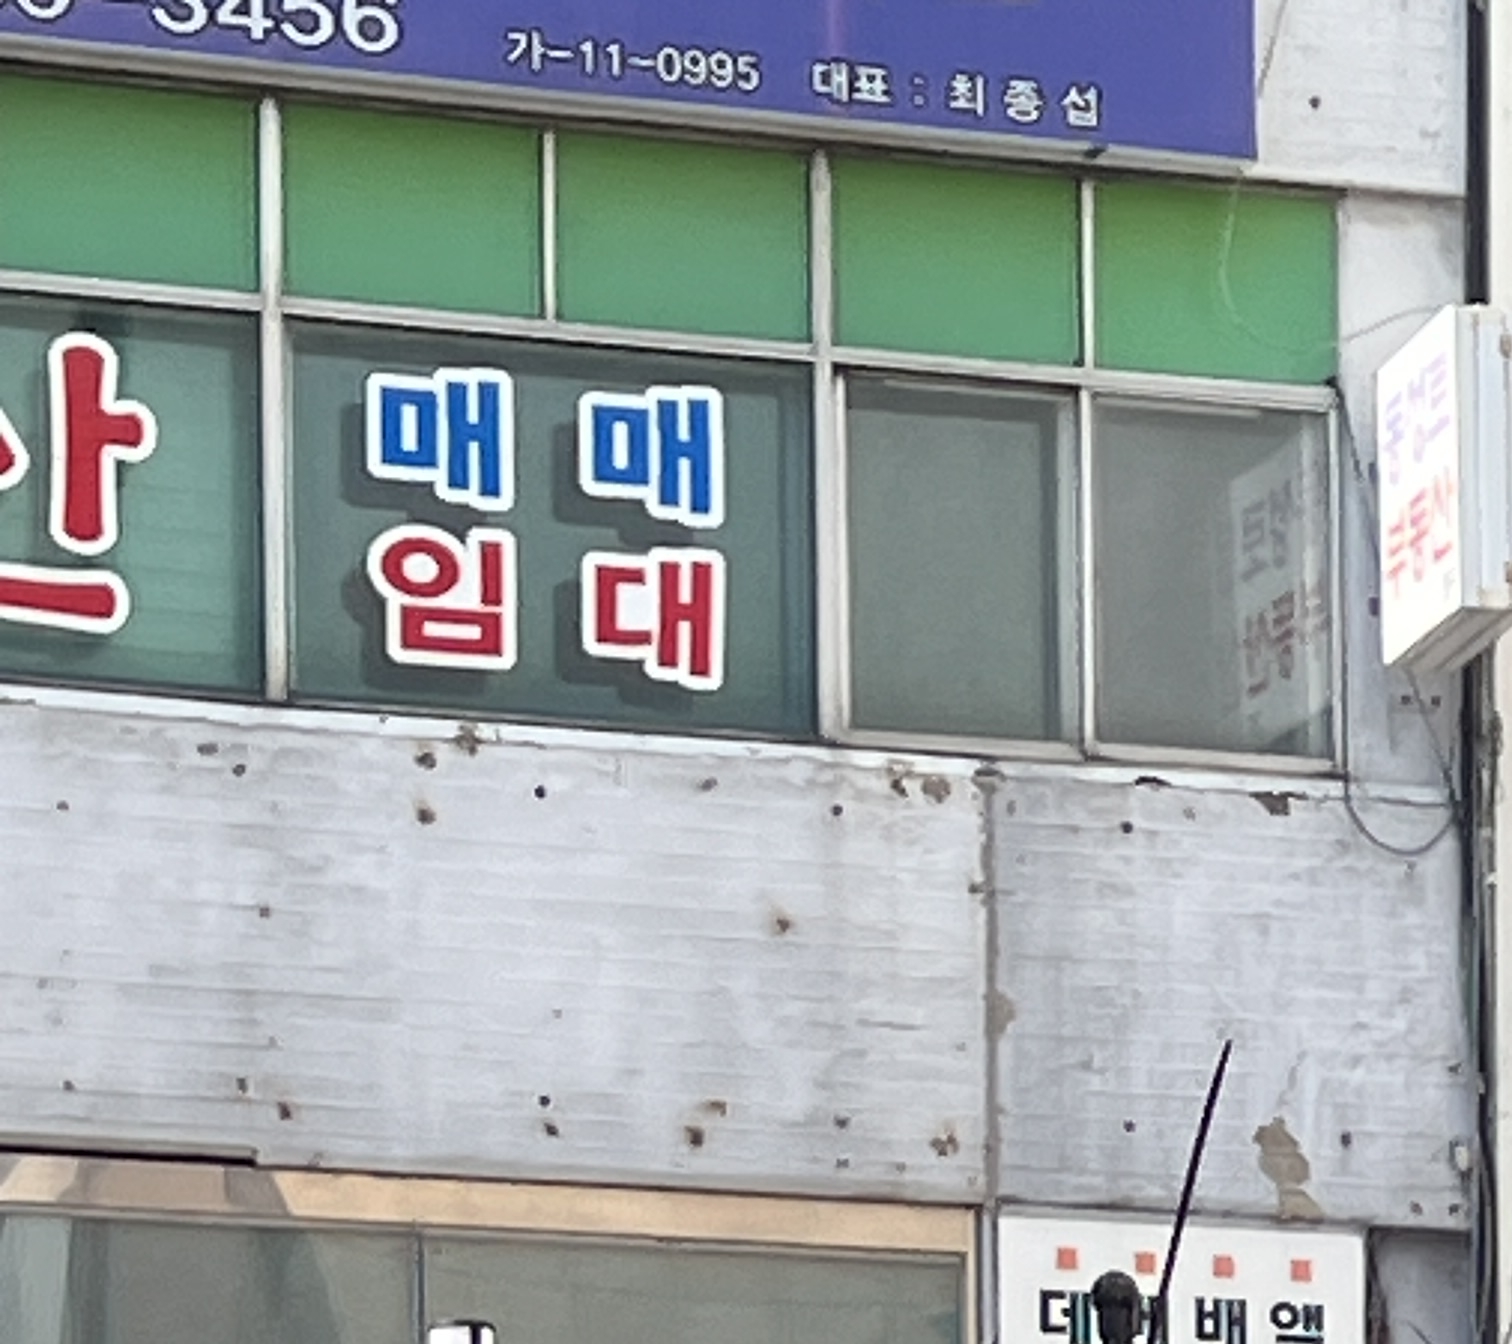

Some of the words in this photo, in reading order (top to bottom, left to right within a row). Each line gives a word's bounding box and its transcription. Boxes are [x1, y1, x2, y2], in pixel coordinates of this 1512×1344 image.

[506, 31, 761, 93] 가-11-0995
[811, 61, 894, 105] 대표
[367, 369, 724, 528] 매매
[367, 526, 724, 690] 임대
